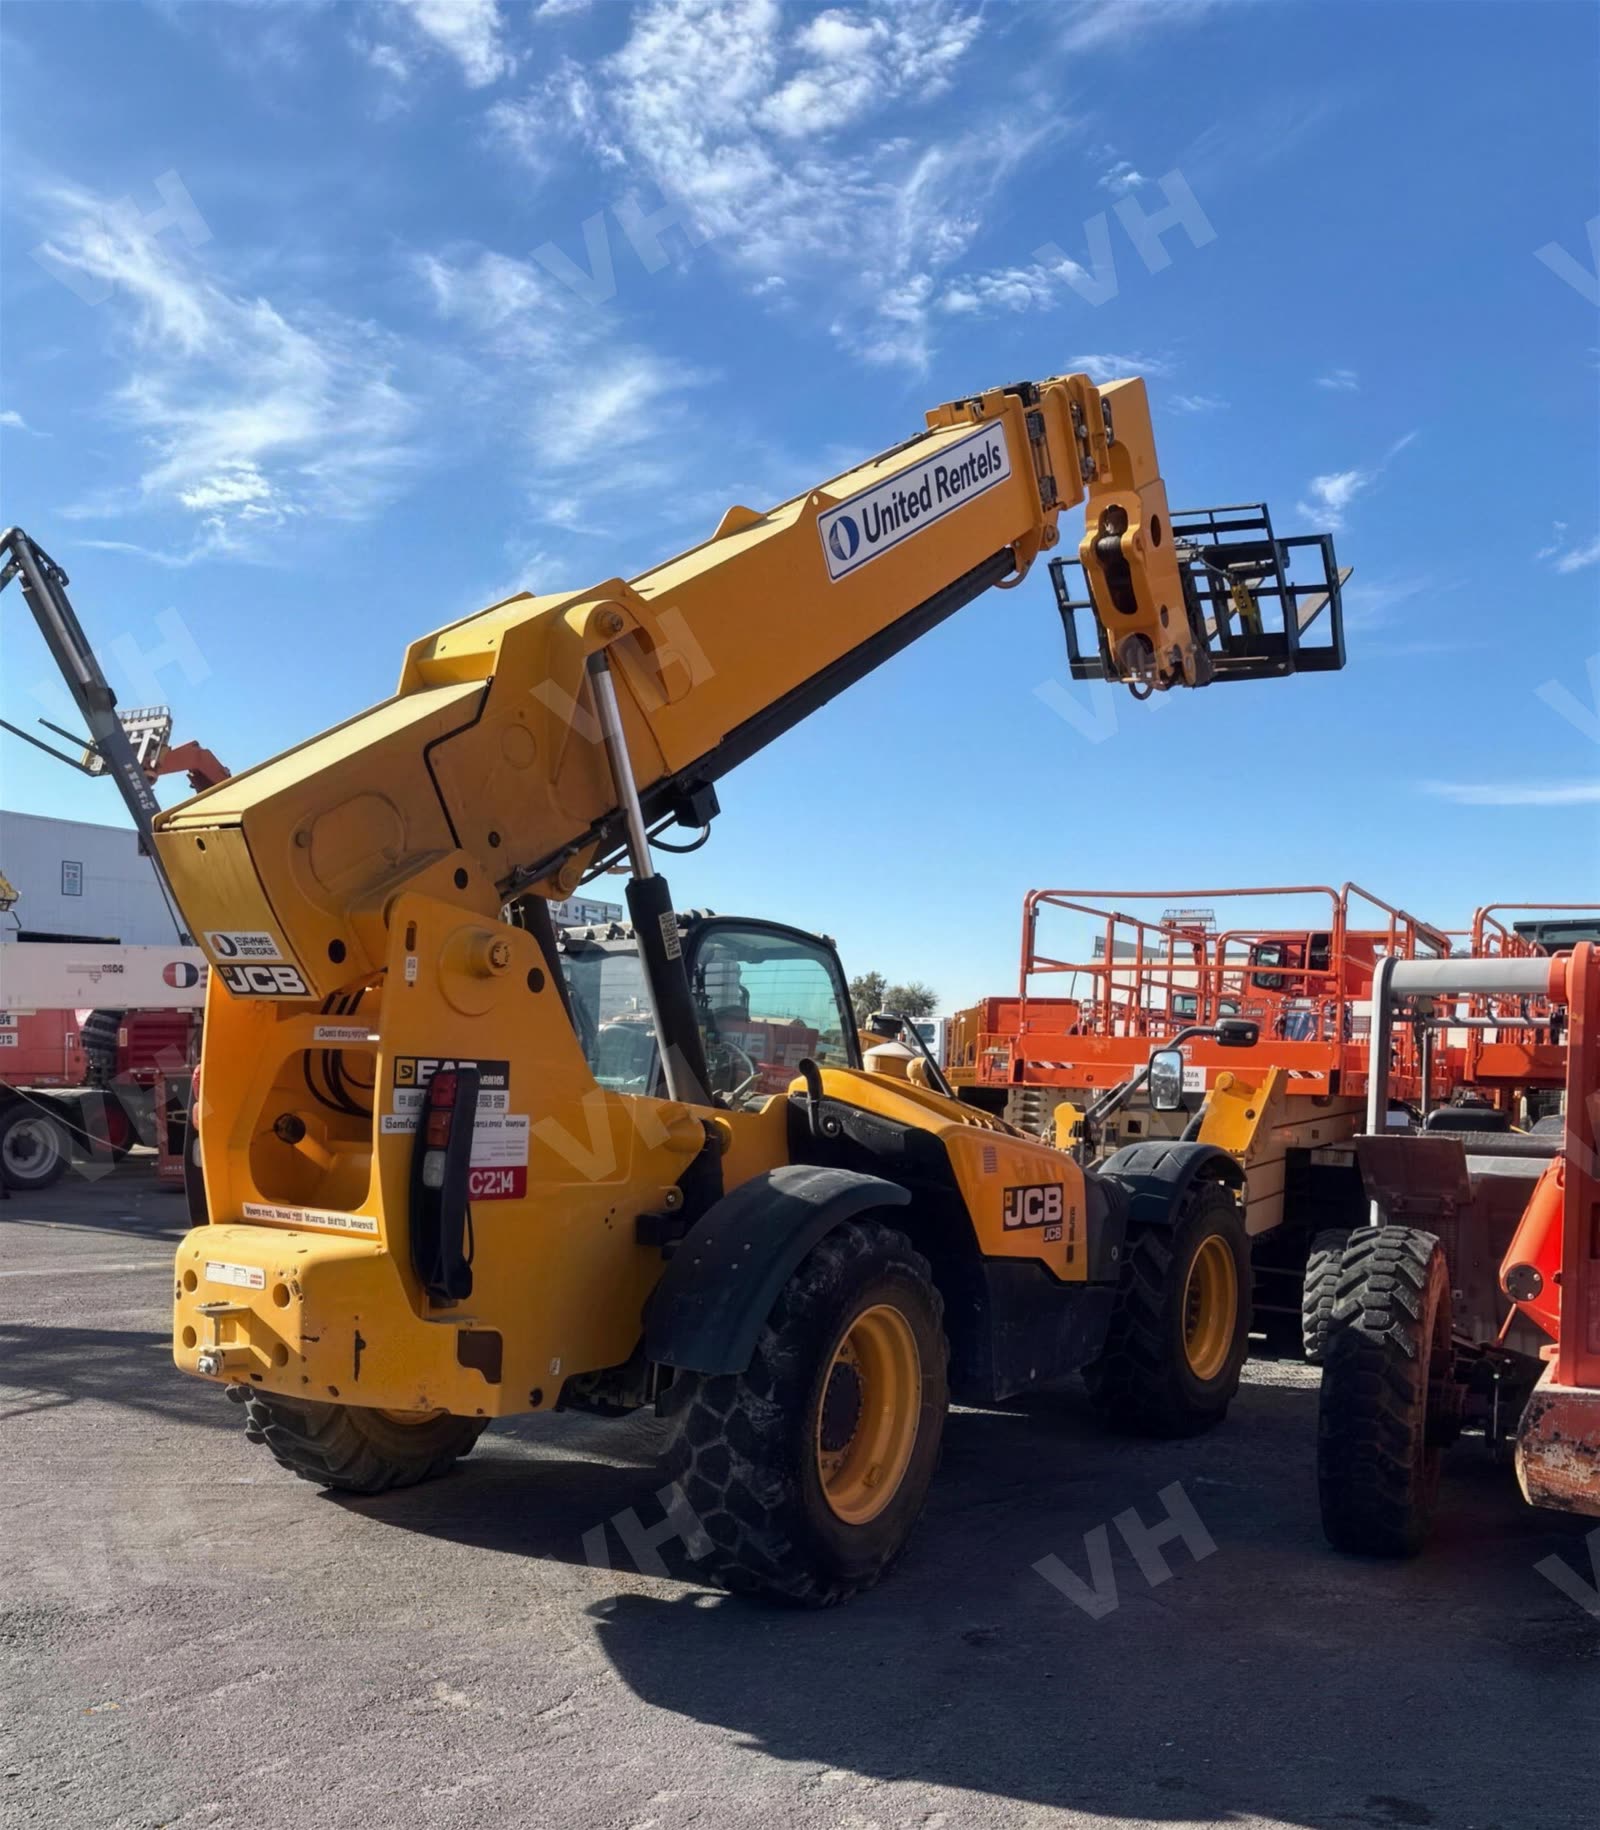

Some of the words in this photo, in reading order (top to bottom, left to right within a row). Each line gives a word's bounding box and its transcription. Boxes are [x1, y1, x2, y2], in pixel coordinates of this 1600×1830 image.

[862, 473, 933, 543] United
[934, 440, 1002, 503] Rentels
[227, 966, 306, 994] JCB
[1005, 1186, 1062, 1226] JCB
[1044, 1226, 1062, 1241] JCB
